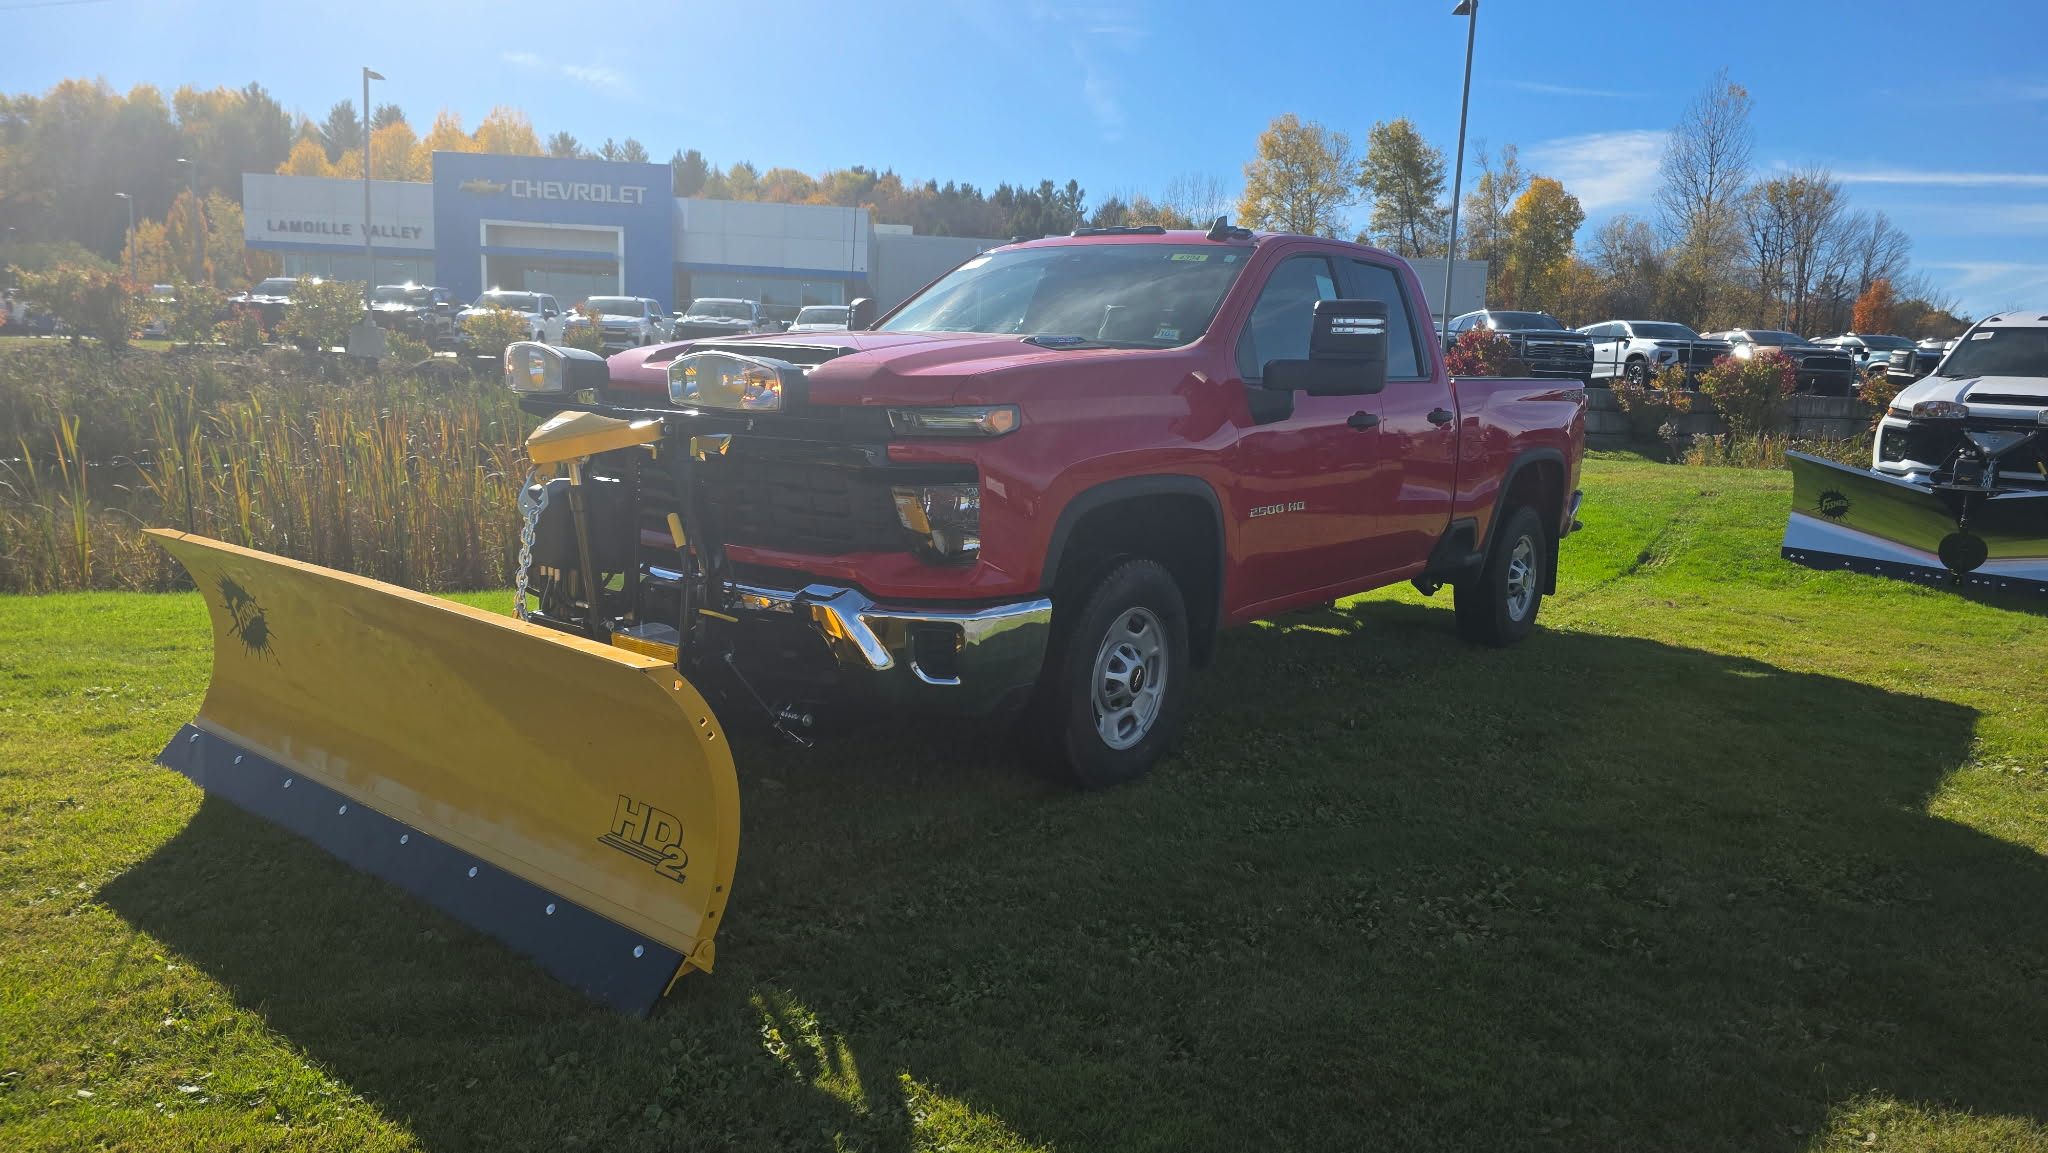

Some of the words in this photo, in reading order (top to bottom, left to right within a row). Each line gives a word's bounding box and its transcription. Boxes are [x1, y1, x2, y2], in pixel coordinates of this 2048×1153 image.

[511, 179, 647, 205] CHEVROLET
[267, 219, 352, 236] LAMOILLE
[361, 223, 422, 239] VALLEY
[1249, 504, 1285, 518] 2500
[1288, 501, 1305, 512] HD
